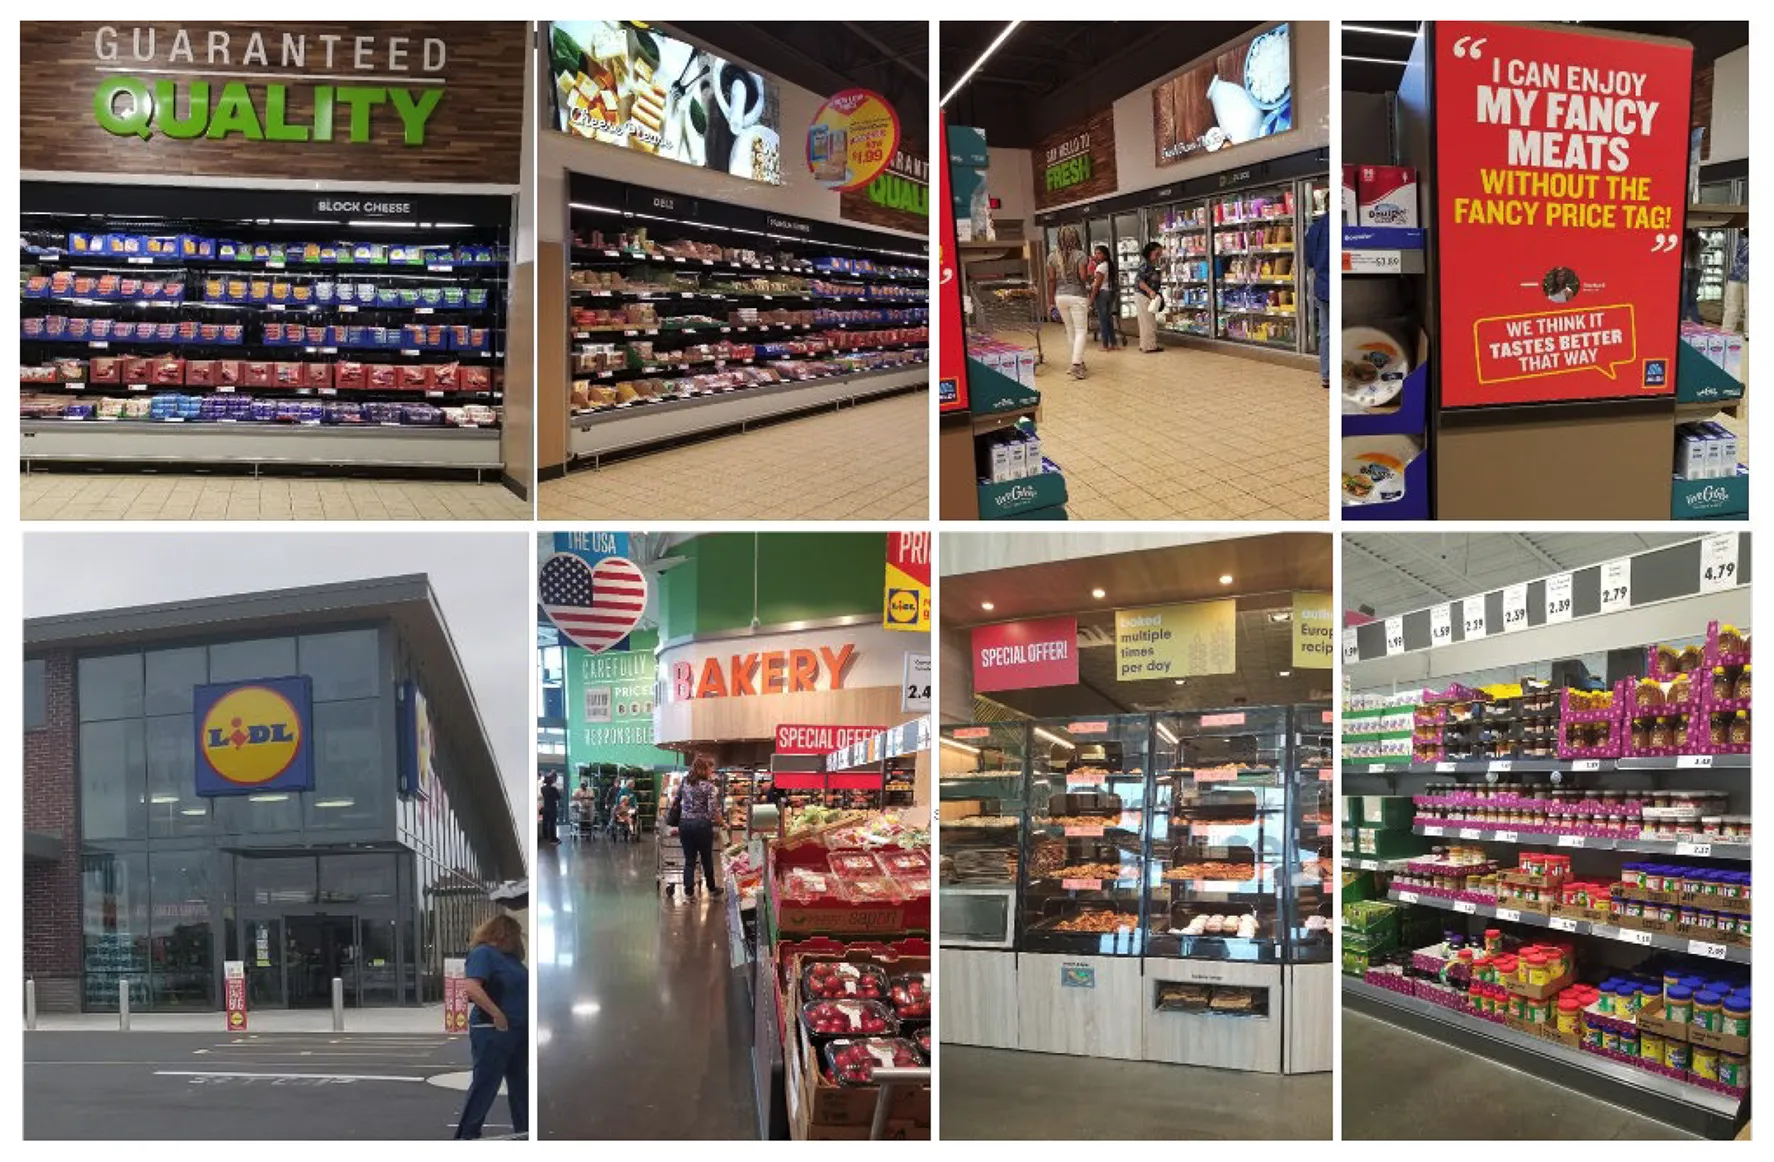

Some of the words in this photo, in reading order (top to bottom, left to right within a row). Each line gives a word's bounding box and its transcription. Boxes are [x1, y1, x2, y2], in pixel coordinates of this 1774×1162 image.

[95, 25, 446, 71] GUARANTEED
[1492, 57, 1500, 83] I
[1508, 59, 1560, 89] CAN
[1567, 65, 1647, 97] ENJOY
[92, 76, 445, 145] QUALITY
[1476, 84, 1539, 126] MY
[1547, 92, 1659, 136] FANCY
[1508, 128, 1630, 173] MEATS
[1045, 154, 1091, 192] FRESH
[1480, 168, 1600, 199] WITHOUT
[1606, 175, 1652, 201] THE
[318, 201, 360, 212] BLOCK
[363, 202, 411, 213] CHEESE
[1454, 198, 1540, 226] FANCY
[1546, 202, 1616, 229] PRICE
[1622, 205, 1673, 230] TAG!
[1506, 319, 1532, 337] WE
[1536, 314, 1586, 333] THINK
[1590, 312, 1604, 328] IT
[1489, 336, 1557, 360] TASTES
[1559, 328, 1623, 351] BETTER
[1519, 353, 1560, 372] THAT
[1564, 347, 1599, 366] WAY
[592, 531, 617, 554] USA
[899, 531, 930, 565] PRI
[1705, 562, 1735, 581] 4.79
[1603, 587, 1627, 603] 2.79
[1120, 614, 1162, 627] baked
[1121, 628, 1172, 644] multiple
[981, 646, 1026, 668] SPECIAL
[1028, 640, 1068, 663] OFFER!
[1121, 647, 1155, 659] times
[582, 654, 646, 679] CAREFULLY
[673, 643, 856, 701] BAKERY
[1121, 663, 1142, 677] per
[1146, 660, 1171, 675] day
[779, 727, 833, 749] SPECIAL
